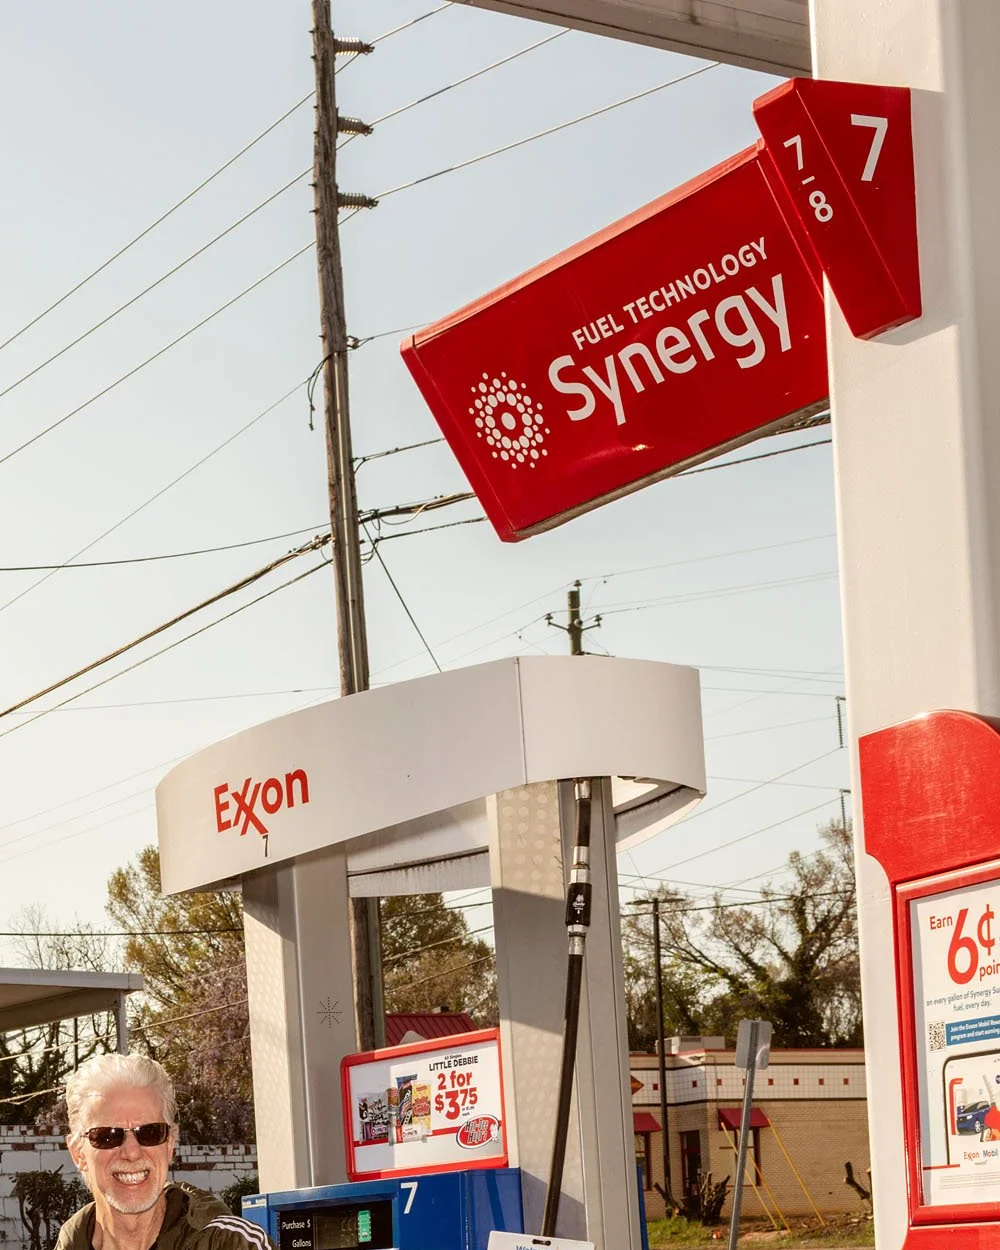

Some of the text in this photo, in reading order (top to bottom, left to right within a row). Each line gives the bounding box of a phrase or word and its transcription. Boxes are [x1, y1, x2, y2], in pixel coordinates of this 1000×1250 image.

[850, 113, 888, 182] 7
[571, 236, 768, 351] FUEL TECHNOLOGY
[548, 273, 791, 426] Synergy
[214, 769, 310, 836] Exxon
[929, 915, 953, 930] Earn
[948, 904, 995, 985] 6¢
[948, 993, 963, 1004] gallon
[970, 989, 992, 1000] Synergy
[429, 1056, 478, 1071] LITTLE DEBBIE
[437, 1070, 472, 1090] 2 for
[963, 1149, 999, 1161] Exxon Mobil
[400, 1181, 418, 1214] 7
[282, 1219, 311, 1230] Purchase $
[292, 1239, 312, 1248] Gallons
